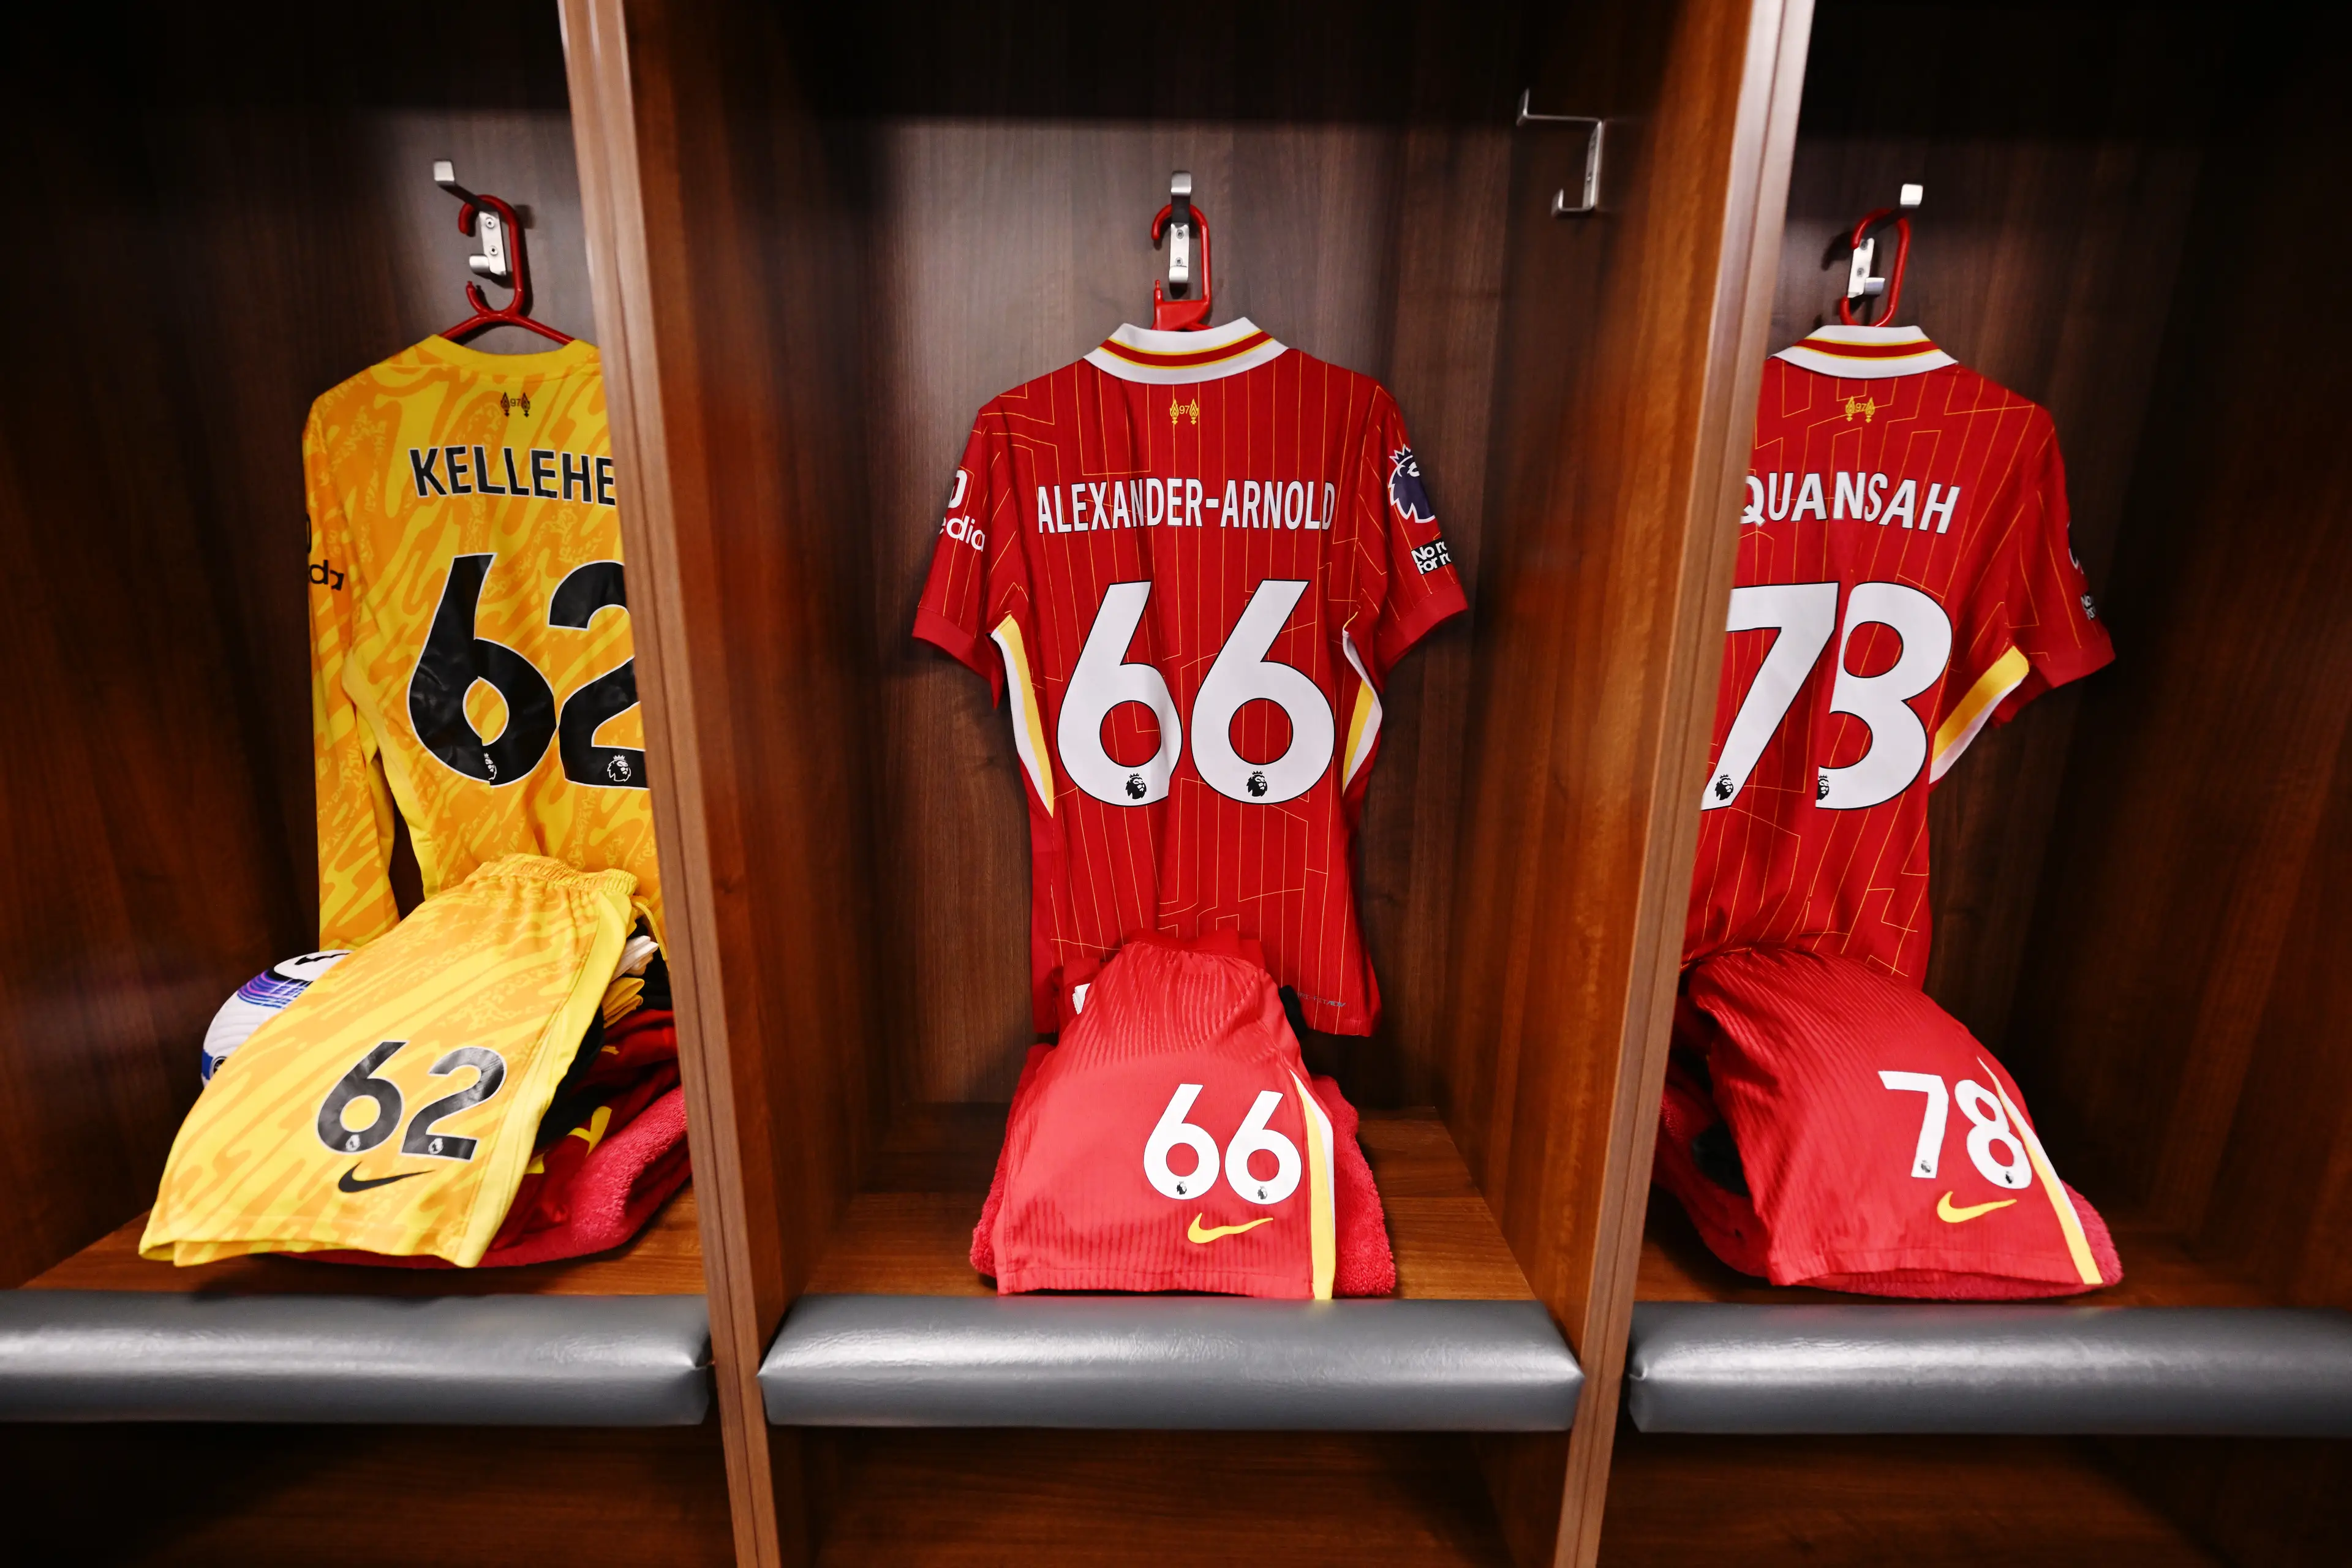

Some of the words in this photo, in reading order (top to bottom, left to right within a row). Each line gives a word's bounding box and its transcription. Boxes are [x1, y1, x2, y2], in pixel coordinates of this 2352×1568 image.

[510, 398, 521, 407] 97
[1179, 405, 1190, 415] 97
[1855, 402, 1868, 412] 97
[408, 445, 617, 508] KELLEHE
[1037, 477, 1336, 534] ALEXANDER-ARNOLD
[1740, 471, 1961, 534] QUANSAH
[1411, 546, 1435, 564] No
[407, 552, 650, 790] 62
[1056, 579, 1336, 807] 66
[1700, 581, 1953, 811] 78
[316, 1040, 507, 1161] 62
[1877, 1070, 2033, 1189] 78
[1143, 1083, 1302, 1205] 66
